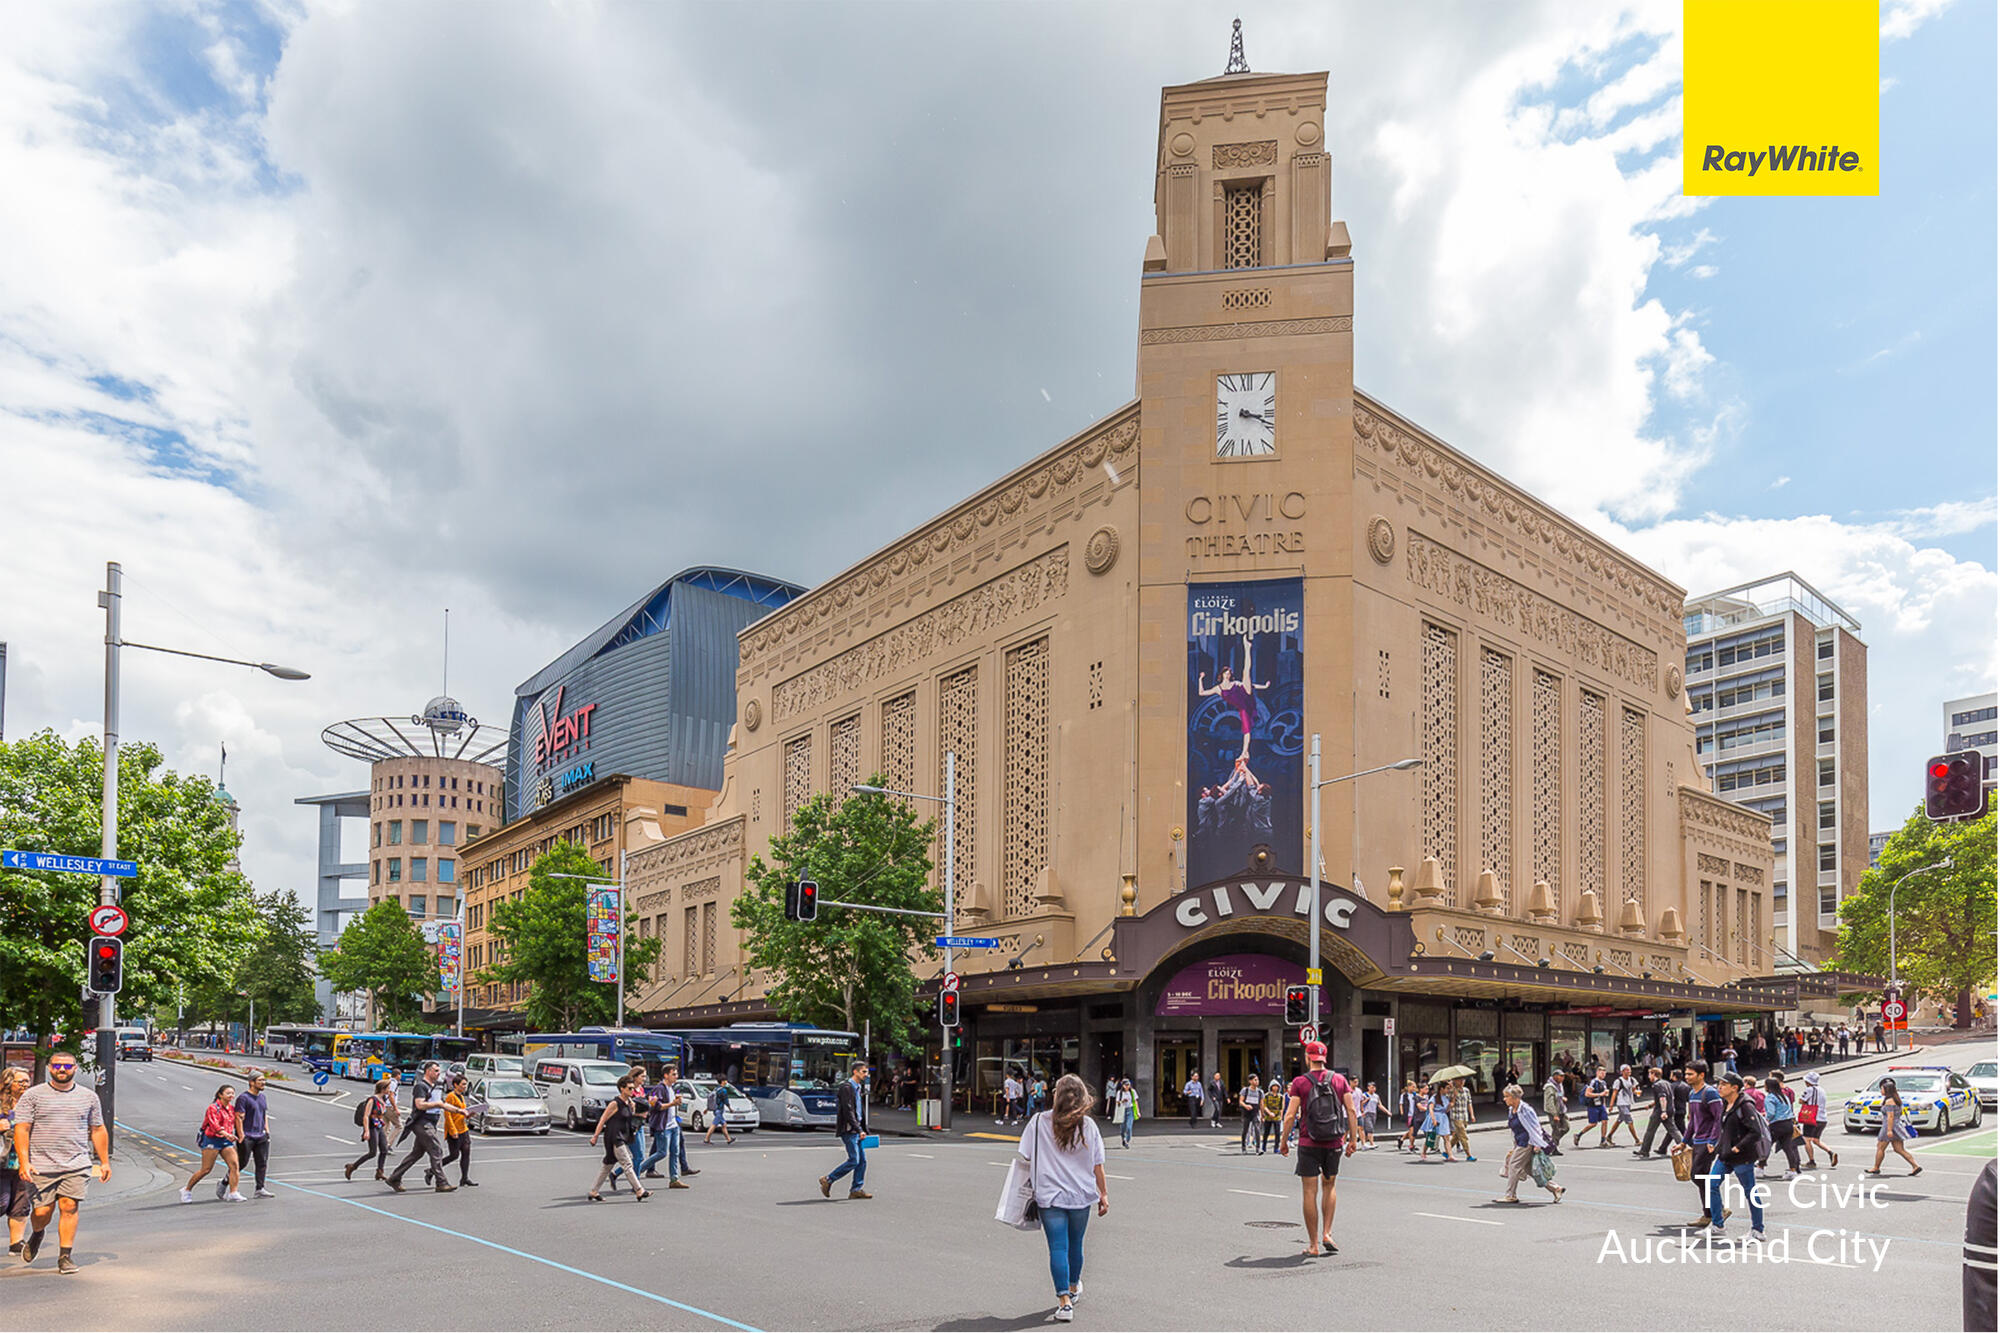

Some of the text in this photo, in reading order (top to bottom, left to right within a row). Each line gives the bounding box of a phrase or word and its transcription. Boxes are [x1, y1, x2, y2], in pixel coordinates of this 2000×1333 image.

[1185, 491, 1306, 525] CIVIC
[1185, 531, 1305, 557] THEATRE
[1192, 608, 1299, 640] Cirkopolis
[535, 685, 596, 764] EVENT
[560, 762, 594, 788] IMAX
[36, 855, 103, 872] WELLESLEY
[116, 862, 131, 870] EAST
[1175, 882, 1357, 929] CIVIC
[1207, 979, 1297, 1002] Cirkopoli
